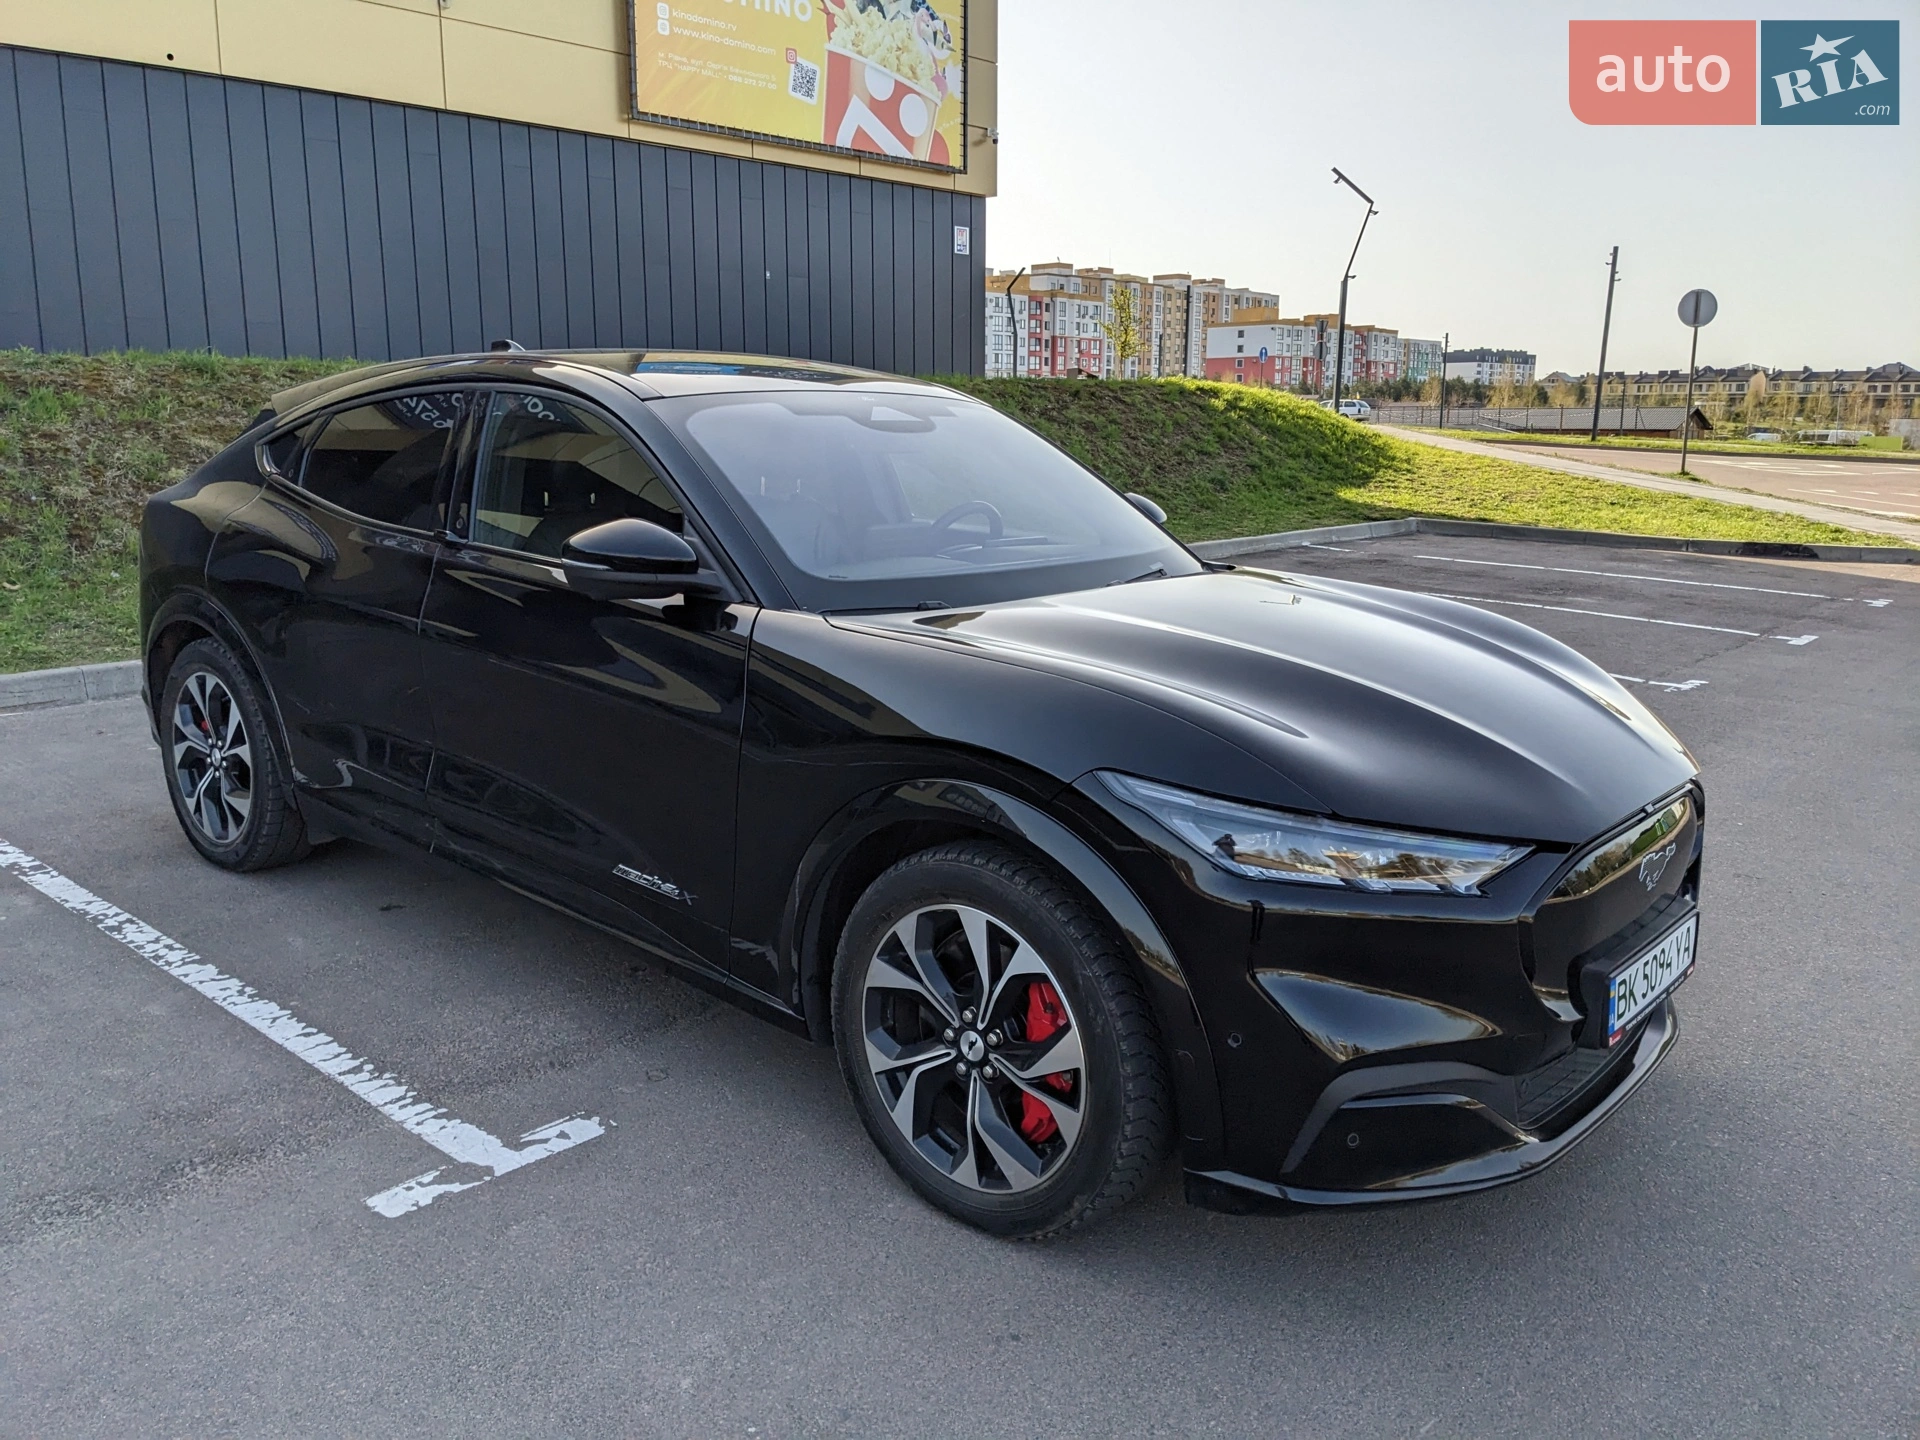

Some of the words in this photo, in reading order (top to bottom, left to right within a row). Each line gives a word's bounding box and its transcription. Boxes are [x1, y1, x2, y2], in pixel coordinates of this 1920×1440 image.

[672, 9, 737, 31] kinodomino.rv
[673, 26, 776, 55] www.kino-domino.com
[1616, 967, 1640, 1022] BK
[1641, 939, 1674, 1000] 5094
[1675, 925, 1692, 971] YA
